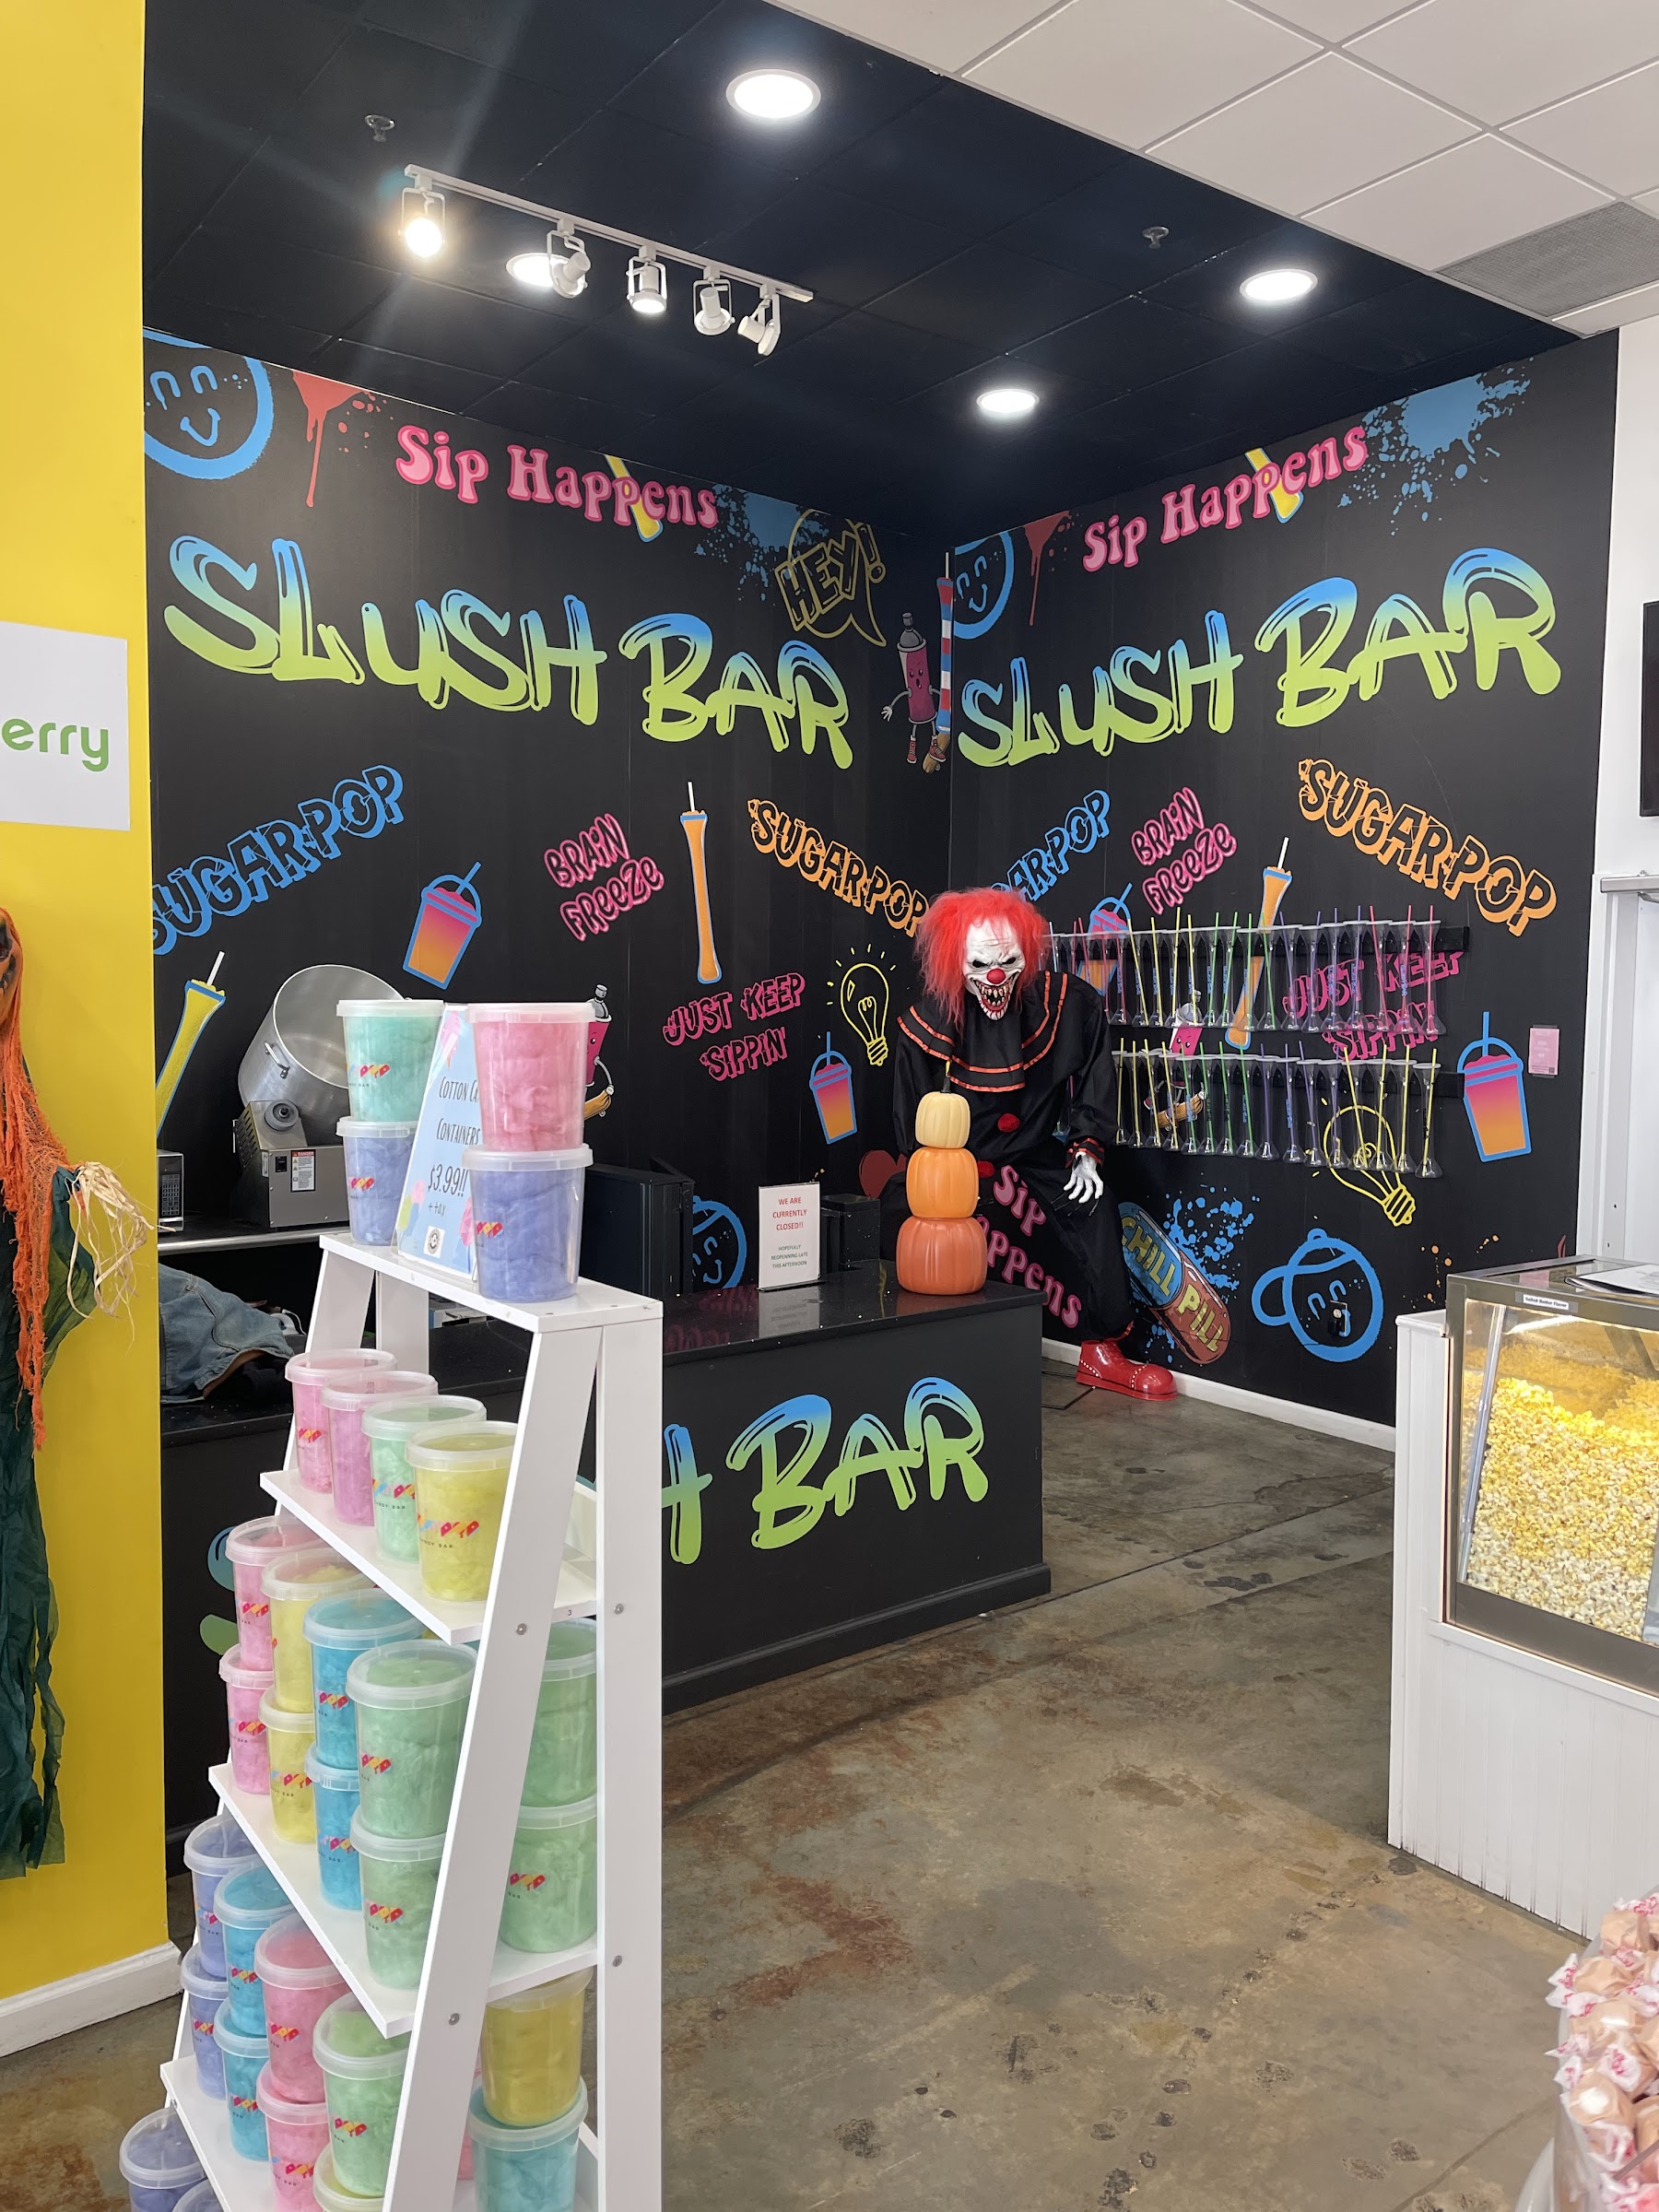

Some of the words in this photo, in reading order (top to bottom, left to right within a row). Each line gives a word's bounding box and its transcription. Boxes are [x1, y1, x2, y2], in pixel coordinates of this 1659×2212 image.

[396, 426, 489, 503] Sip
[507, 444, 719, 528] Happens
[1082, 514, 1147, 572] Sip
[1161, 426, 1368, 543] Happens
[774, 522, 886, 631] HEY!
[164, 535, 607, 725] SLUSH
[618, 613, 853, 770] BAR
[958, 610, 1243, 767] SLUSH
[1255, 547, 1560, 726] BAR
[663, 992, 733, 1046] JUST
[740, 972, 806, 1021] KEEP
[772, 1209, 807, 1218] CURRENTLY
[776, 1221, 804, 1230] CLOSED!!
[994, 1164, 1047, 1236] Sip
[976, 1216, 1083, 1328] ppens
[1121, 1217, 1177, 1297] CHILL
[1177, 1283, 1225, 1353] PILL
[725, 1376, 989, 1549] BAR
